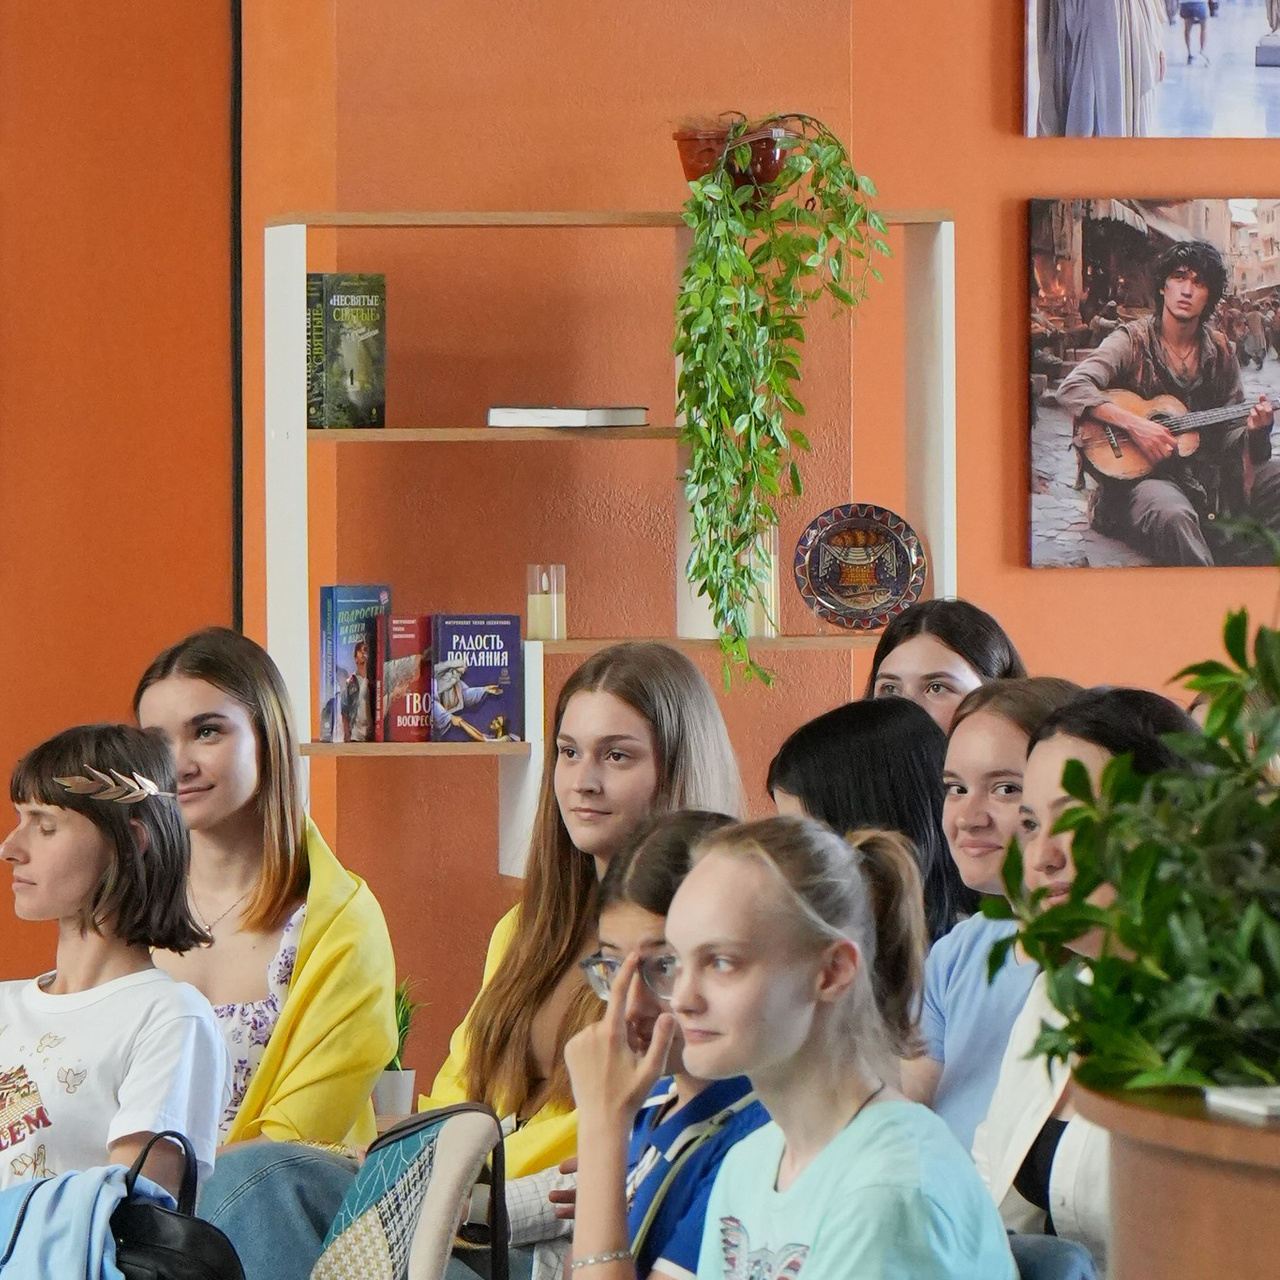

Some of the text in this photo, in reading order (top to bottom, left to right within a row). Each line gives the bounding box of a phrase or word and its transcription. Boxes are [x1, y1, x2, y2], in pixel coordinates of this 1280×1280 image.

[452, 634, 504, 651] РАДОСТЬ
[447, 651, 509, 667] ПОКАЯНИЯ
[405, 692, 431, 714] ТВО
[397, 715, 432, 727] ВОСКРЕС
